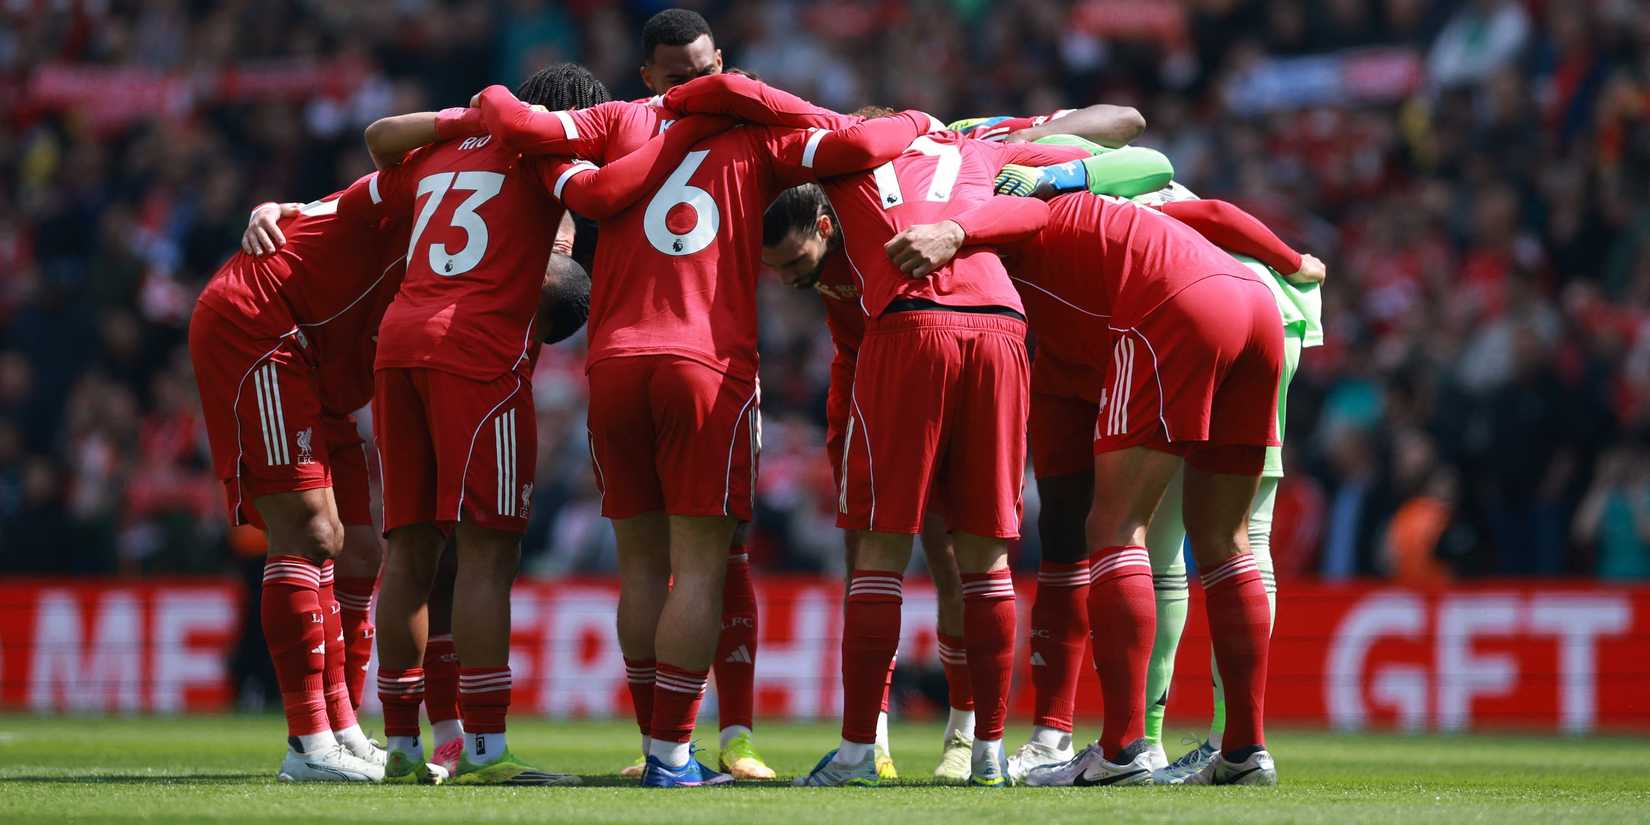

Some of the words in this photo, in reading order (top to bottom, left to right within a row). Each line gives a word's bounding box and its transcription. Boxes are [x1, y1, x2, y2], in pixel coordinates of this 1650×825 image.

[406, 170, 507, 277] 73
[643, 149, 720, 256] 6
[873, 135, 963, 211] 17
